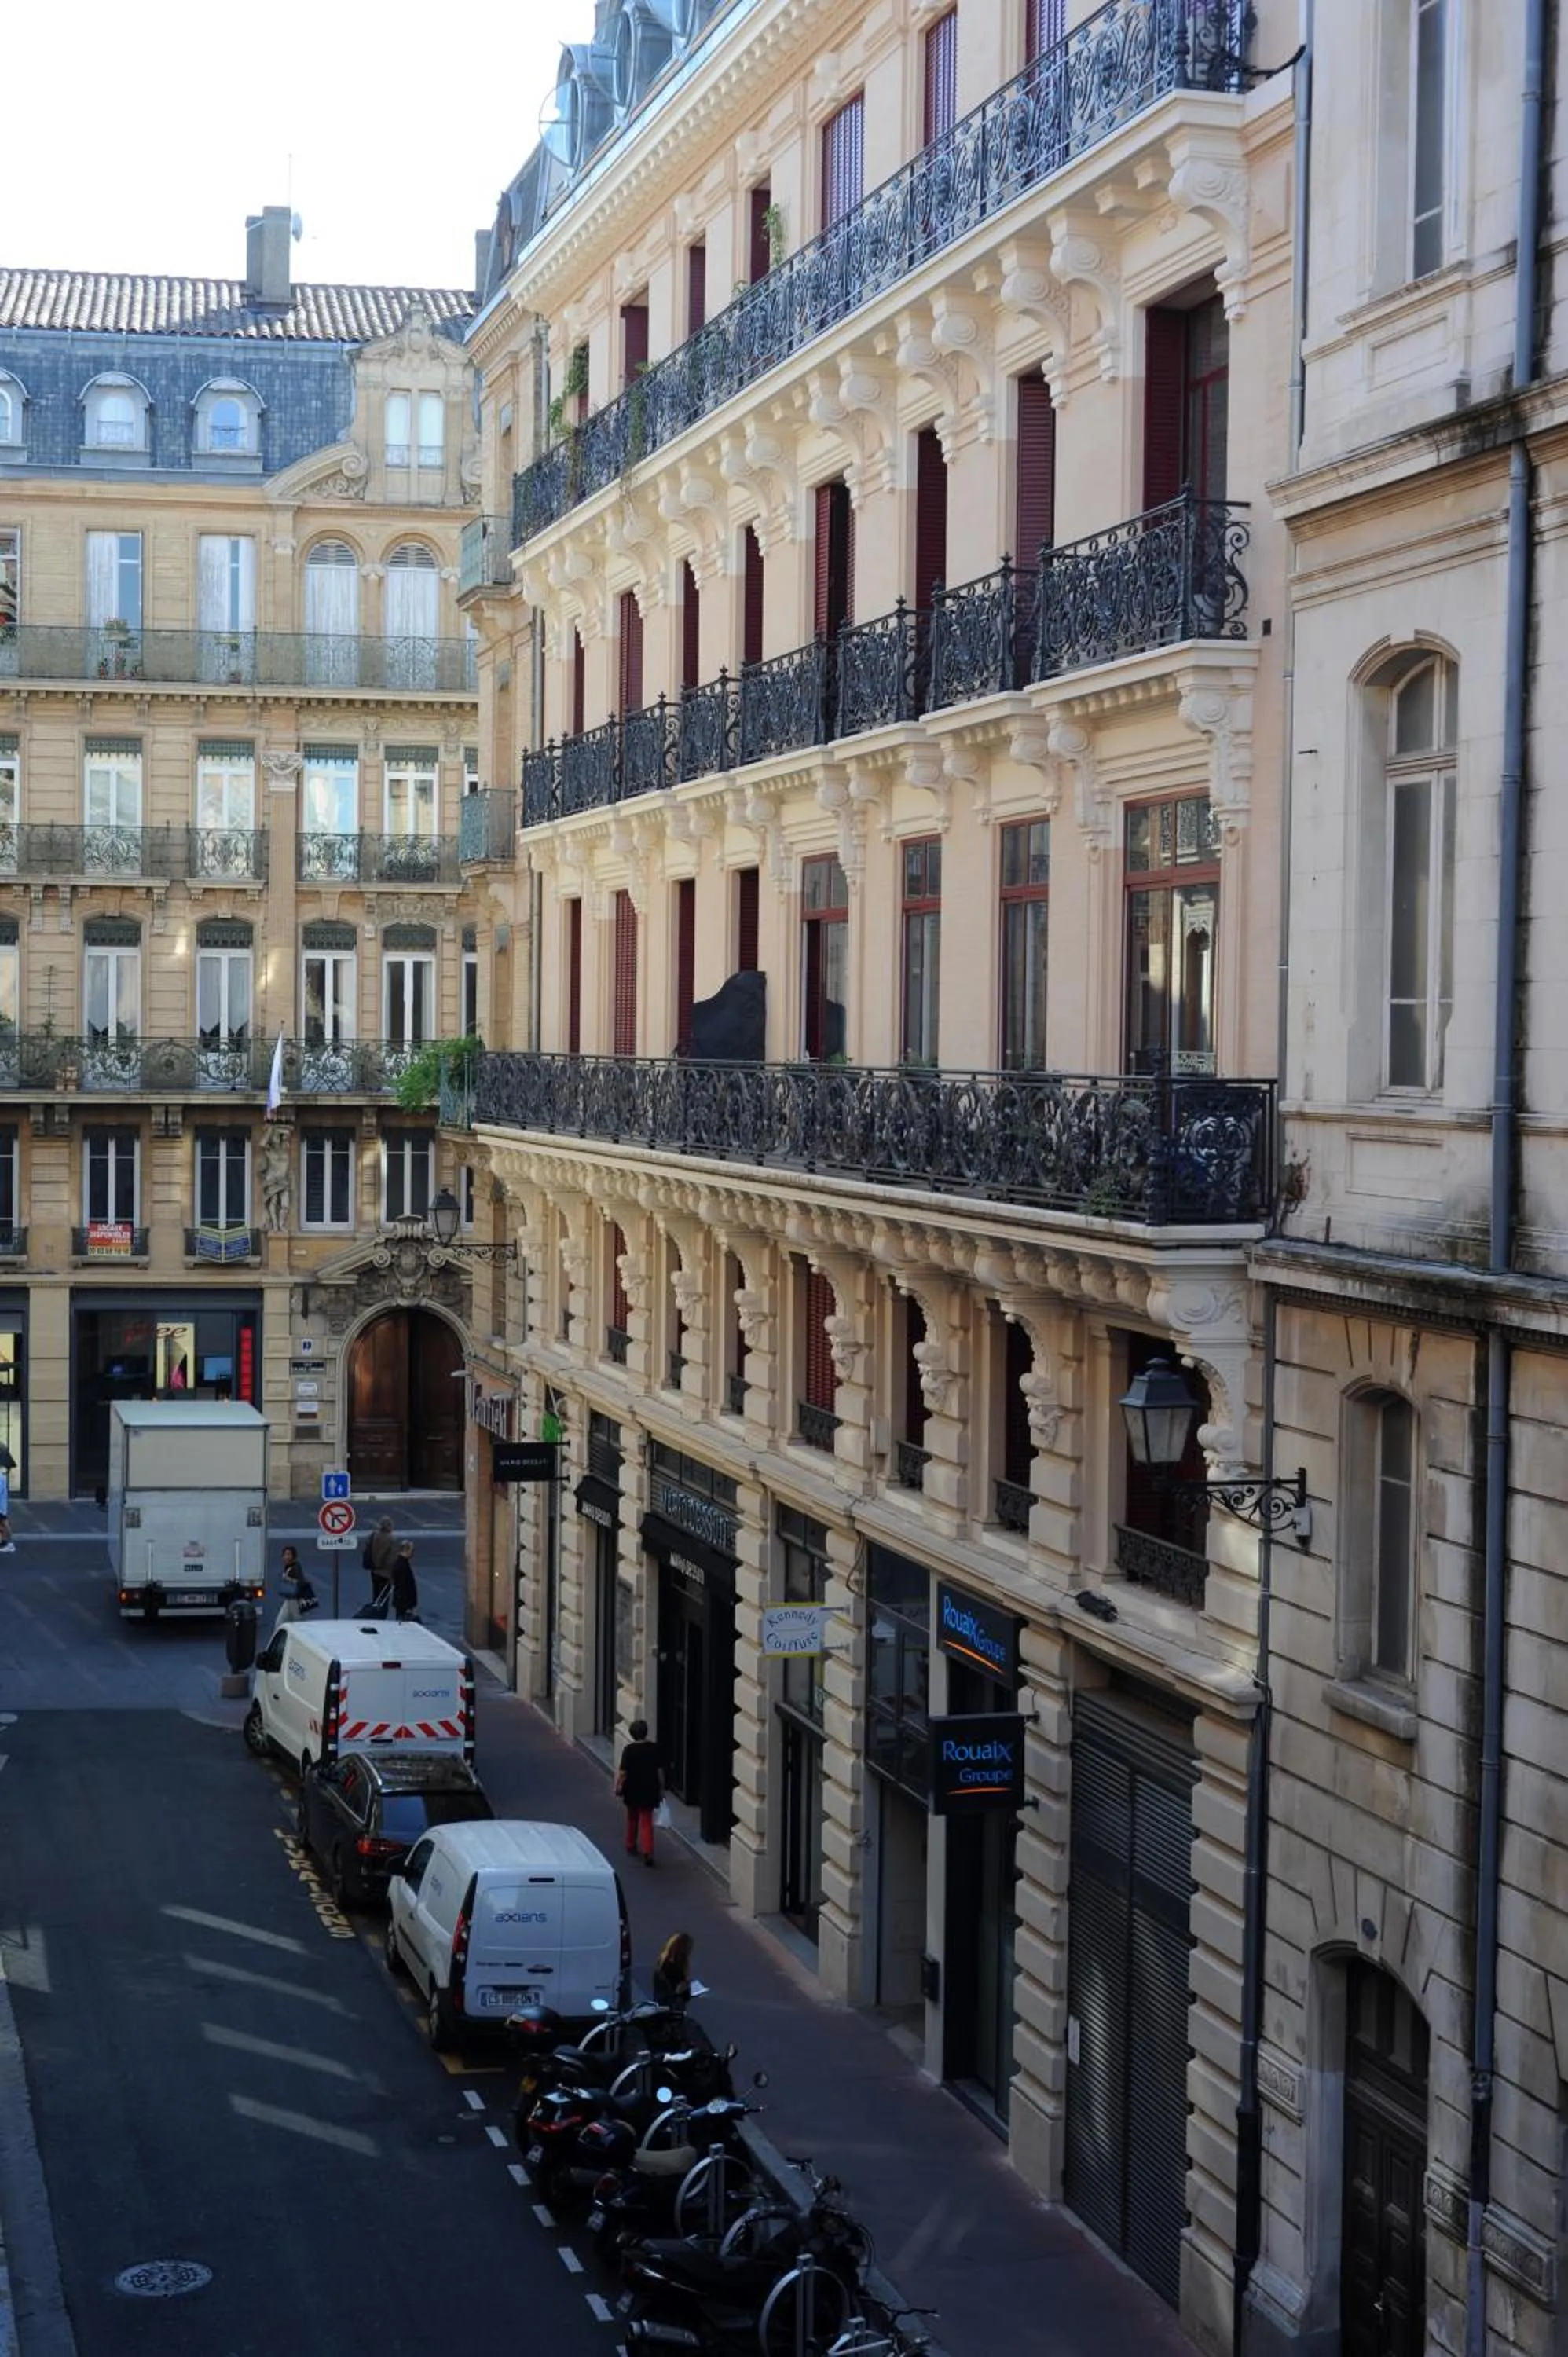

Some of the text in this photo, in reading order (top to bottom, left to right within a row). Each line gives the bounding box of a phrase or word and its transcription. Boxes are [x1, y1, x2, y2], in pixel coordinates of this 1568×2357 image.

[766, 1611, 818, 1628] Kennedy
[942, 1596, 1006, 1663] Rouaix Groupe
[766, 1632, 818, 1651] Coiffure
[942, 1739, 1015, 1763] Rouaix
[958, 1766, 1014, 1784] Groupe
[273, 1828, 357, 1939] LIVRAISONS
[494, 1912, 548, 1923] axians
